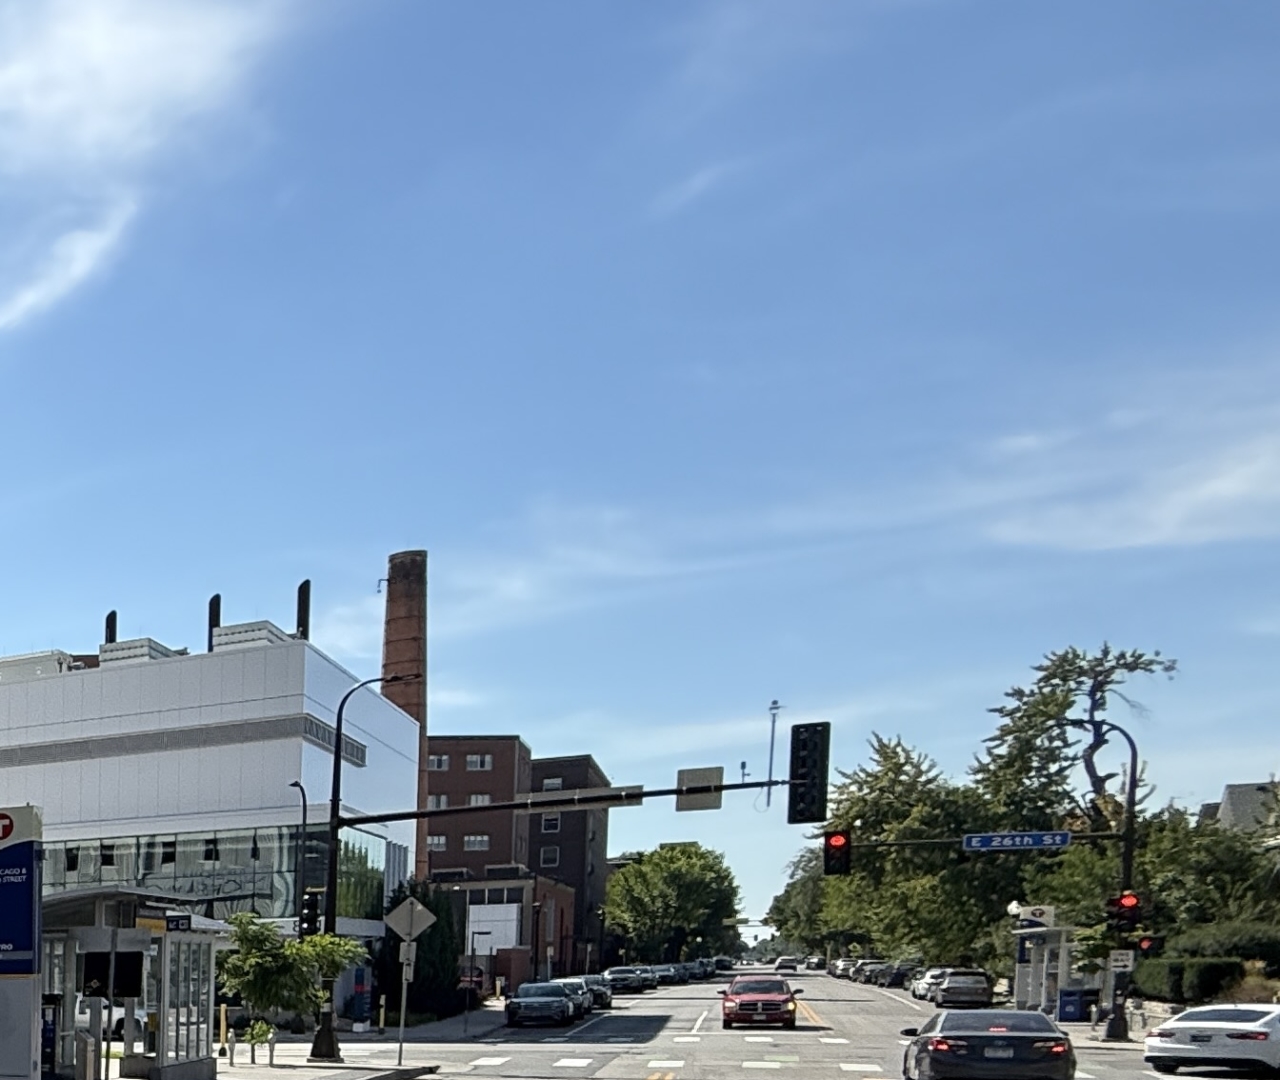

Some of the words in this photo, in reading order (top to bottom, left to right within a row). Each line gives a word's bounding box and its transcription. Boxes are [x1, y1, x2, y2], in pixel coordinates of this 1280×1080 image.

[971, 837, 982, 847] E
[991, 836, 1034, 847] 26th
[1042, 835, 1063, 845] St
